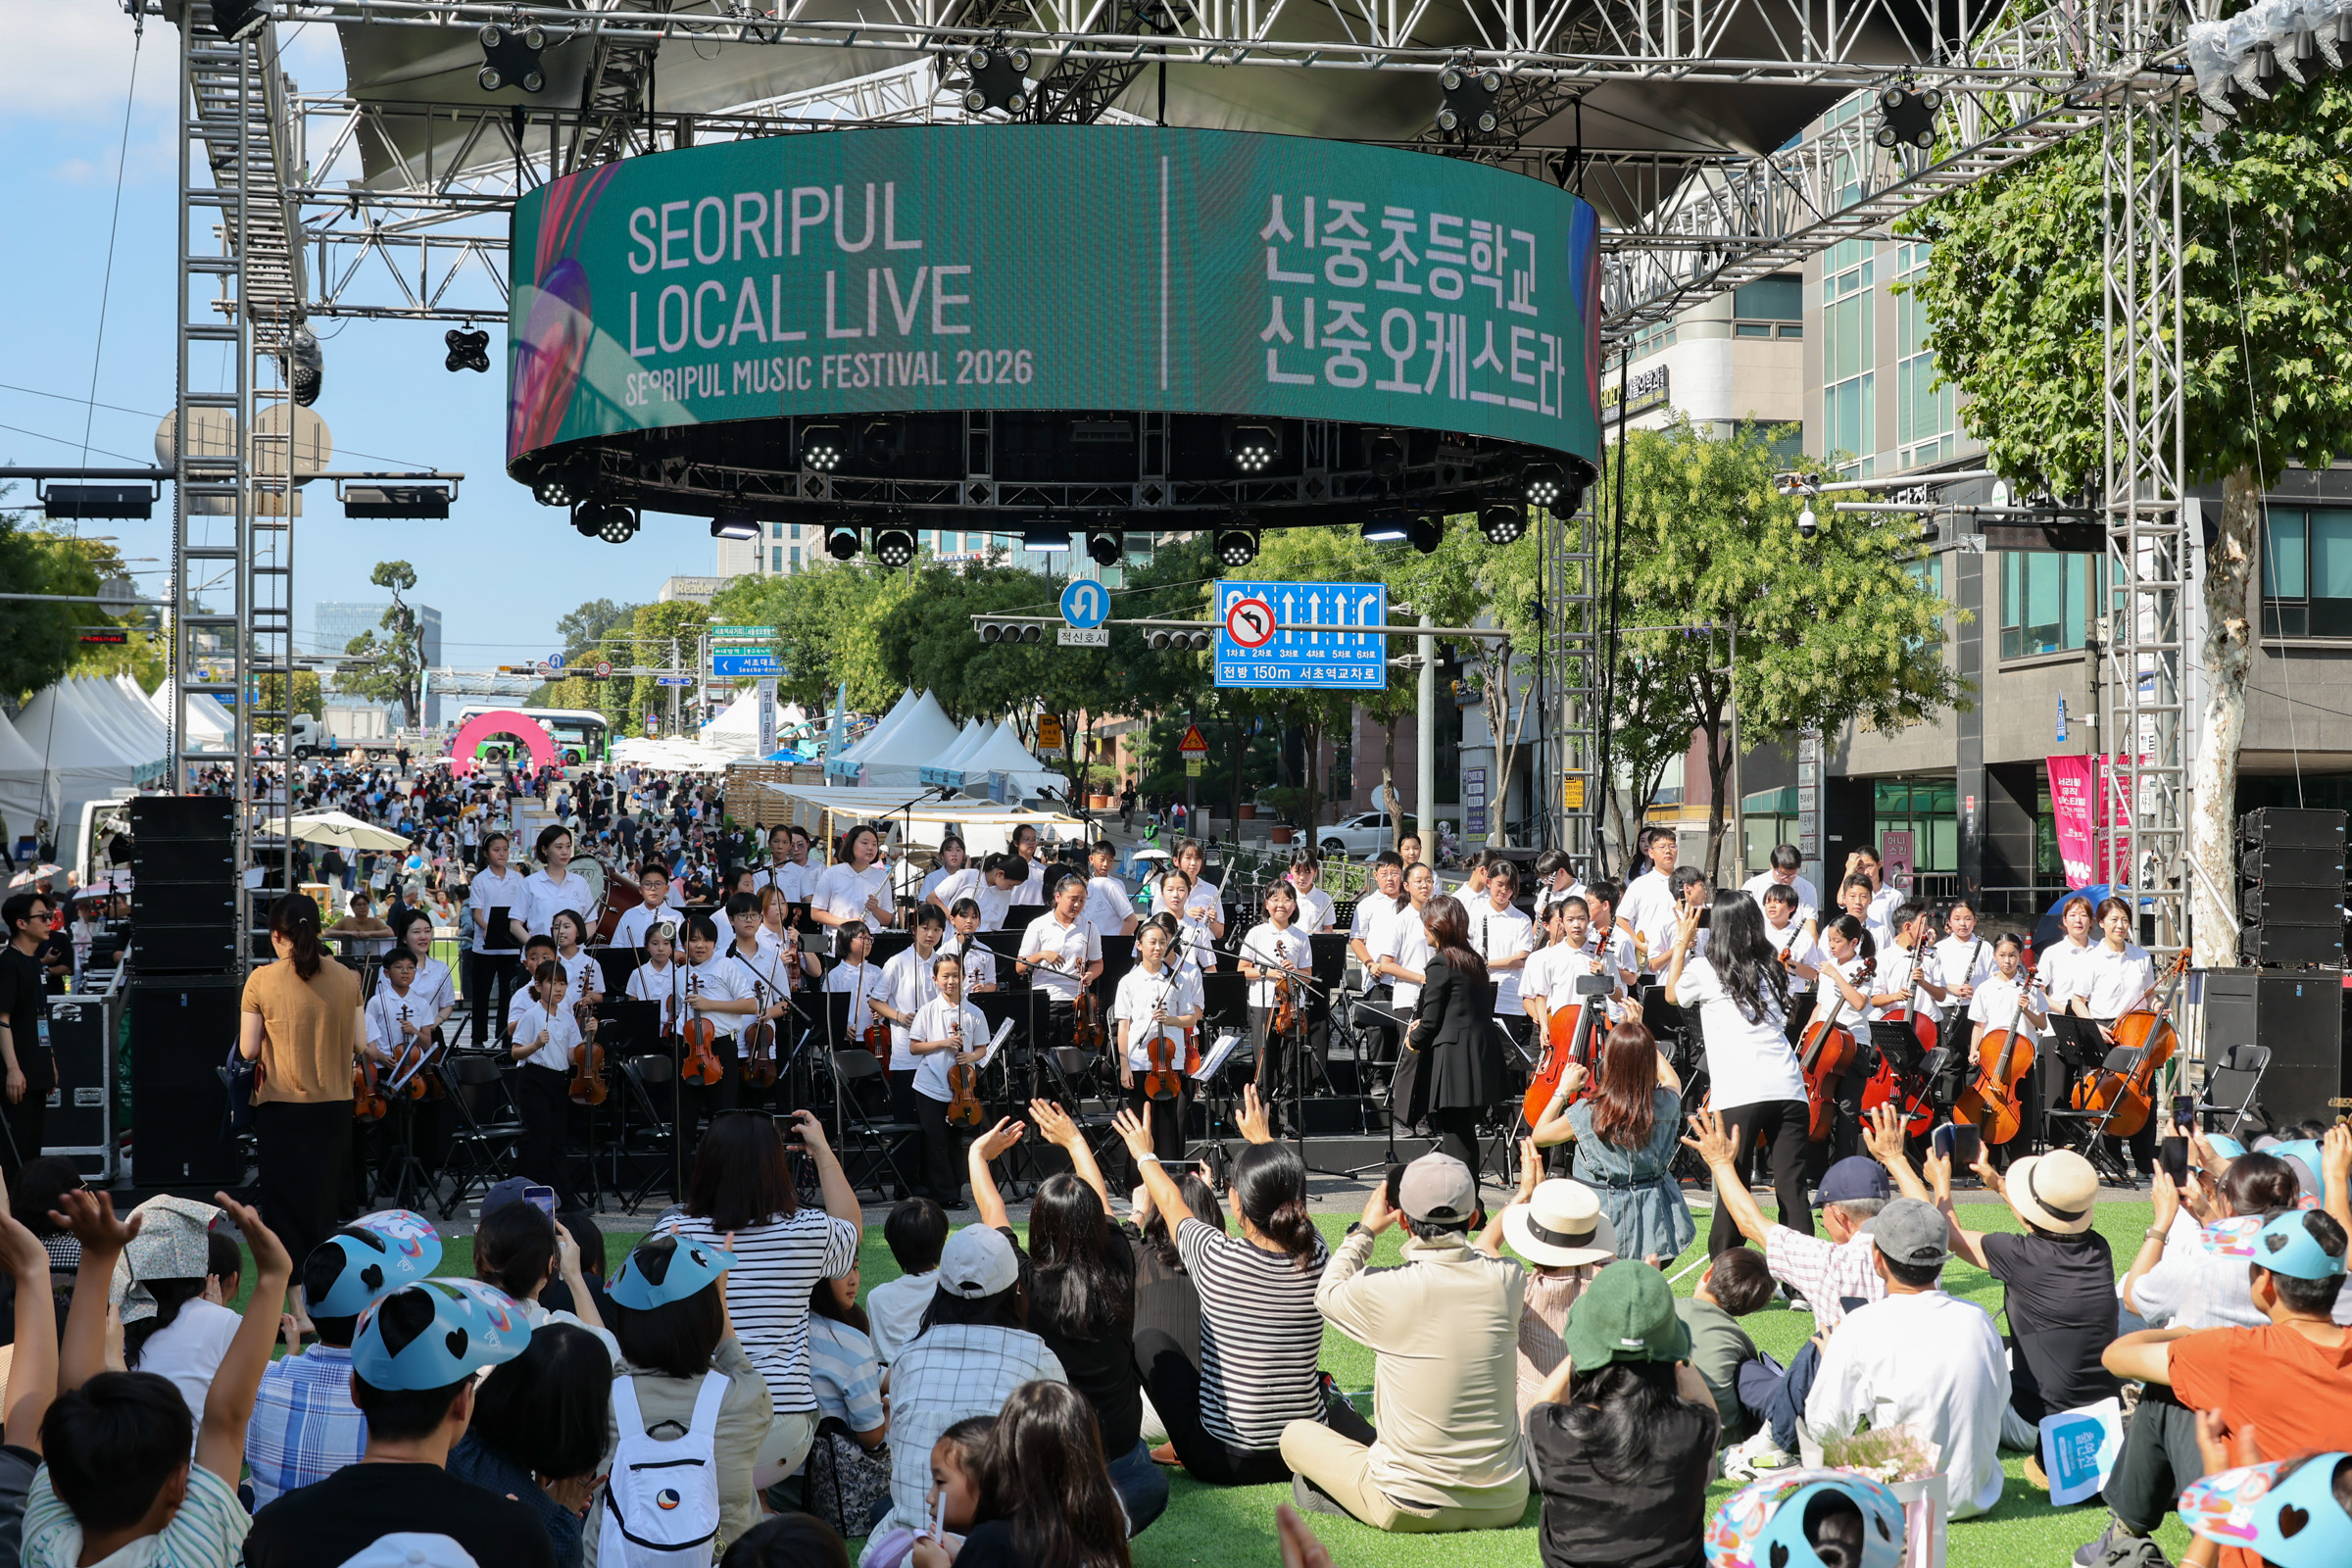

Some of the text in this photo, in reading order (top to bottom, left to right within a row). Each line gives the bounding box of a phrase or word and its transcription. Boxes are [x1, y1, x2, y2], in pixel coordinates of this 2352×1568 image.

[628, 182, 923, 274] SEORIPUL
[1260, 194, 1539, 317] 신중초등학교
[630, 265, 972, 358] LOCAL LIVE
[1260, 296, 1566, 419] 신중오케스트라
[625, 349, 1034, 407] SEORIPUL MUSIC FESTIVAL 2026
[676, 581, 715, 595] Reader
[1061, 631, 1106, 644] 적신호시
[1226, 649, 1246, 658] 1차로
[1252, 649, 1272, 658] 2차로
[1280, 649, 1299, 658] 3차로
[1332, 650, 1351, 659] 5차로
[744, 658, 777, 666] 서초대로
[599, 664, 610, 673] 50
[1223, 665, 1376, 681] 전방 150m 서초역교차로
[2058, 777, 2082, 787] 서리풀
[2062, 787, 2078, 796] 뮤직
[1889, 846, 1908, 856] 스킨
[2075, 1431, 2097, 1470] 출연진
